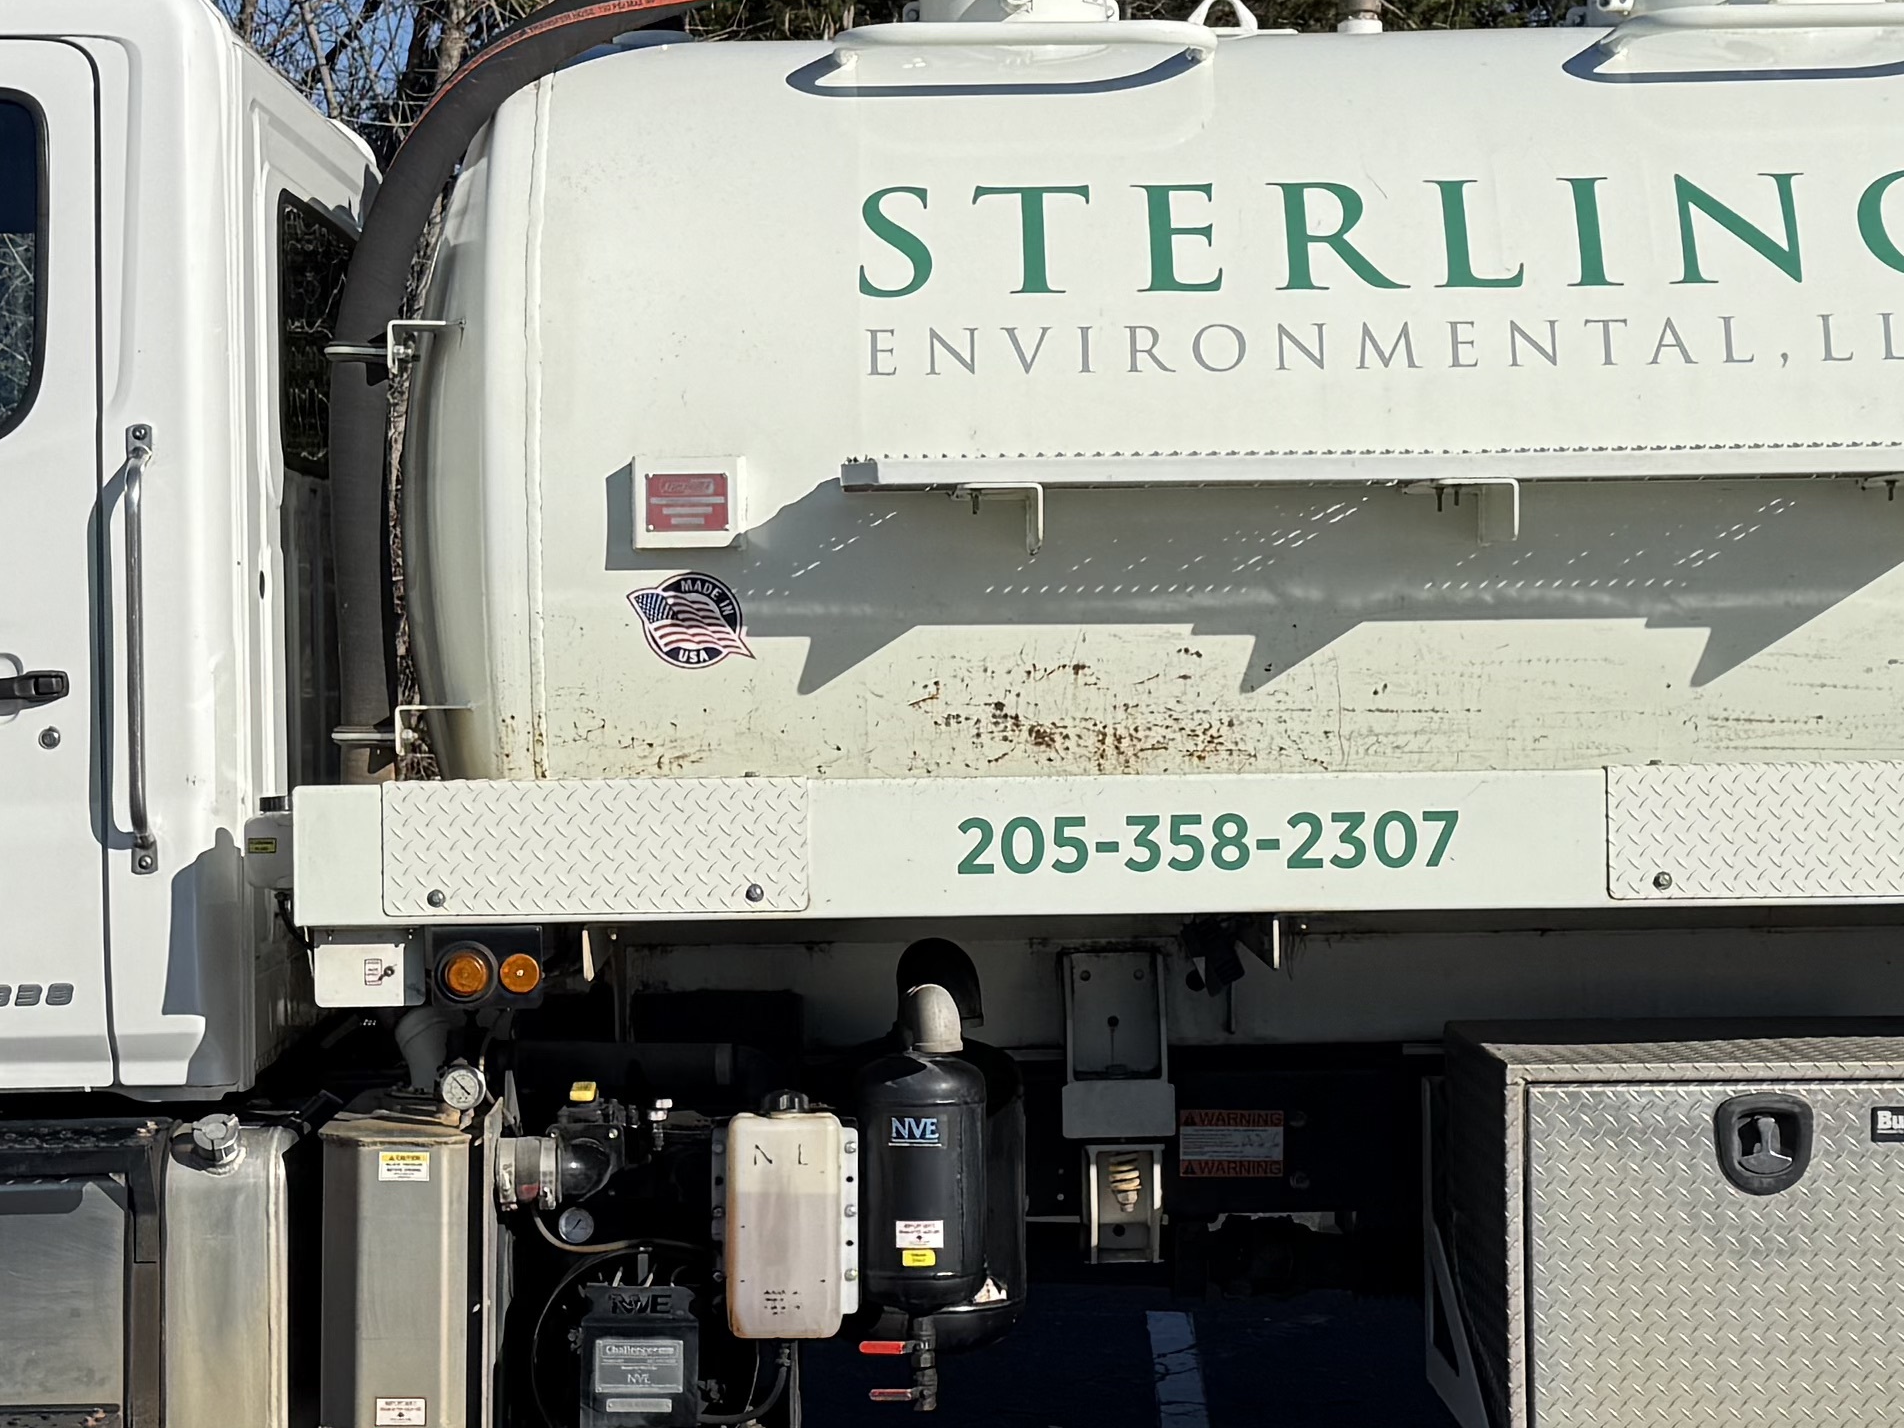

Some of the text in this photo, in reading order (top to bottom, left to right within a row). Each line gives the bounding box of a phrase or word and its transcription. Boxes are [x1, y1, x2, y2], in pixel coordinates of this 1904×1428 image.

[681, 579, 735, 617] MADE IN
[678, 649, 710, 663] USA
[958, 810, 1460, 876] 205-358-2307
[1199, 1111, 1283, 1126] WARNING
[891, 1117, 939, 1139] NVE
[1198, 1161, 1282, 1175] WARNING
